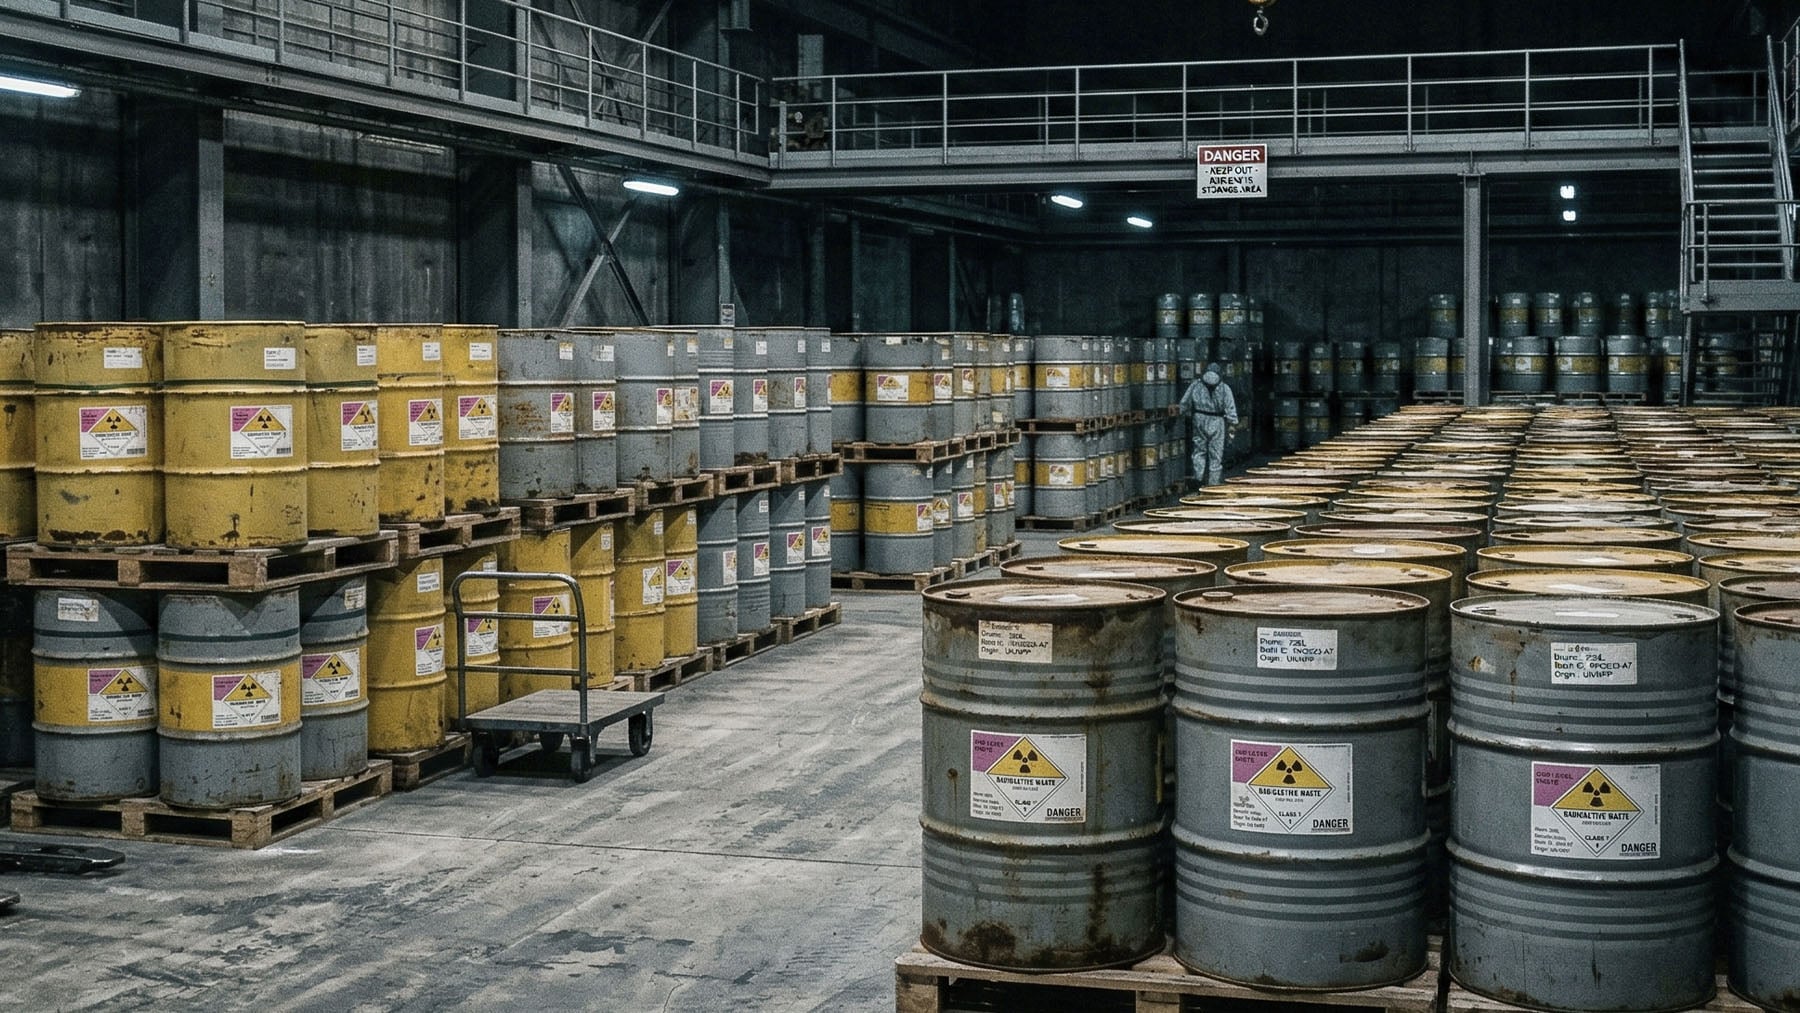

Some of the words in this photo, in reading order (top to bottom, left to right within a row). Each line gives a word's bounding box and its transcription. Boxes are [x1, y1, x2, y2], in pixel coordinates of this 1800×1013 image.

[1204, 149, 1260, 162] DANGER
[1234, 166, 1253, 174] OUT
[1046, 807, 1081, 817] DANGER
[1312, 819, 1349, 828] DANGER
[1621, 842, 1657, 852] DANGER
